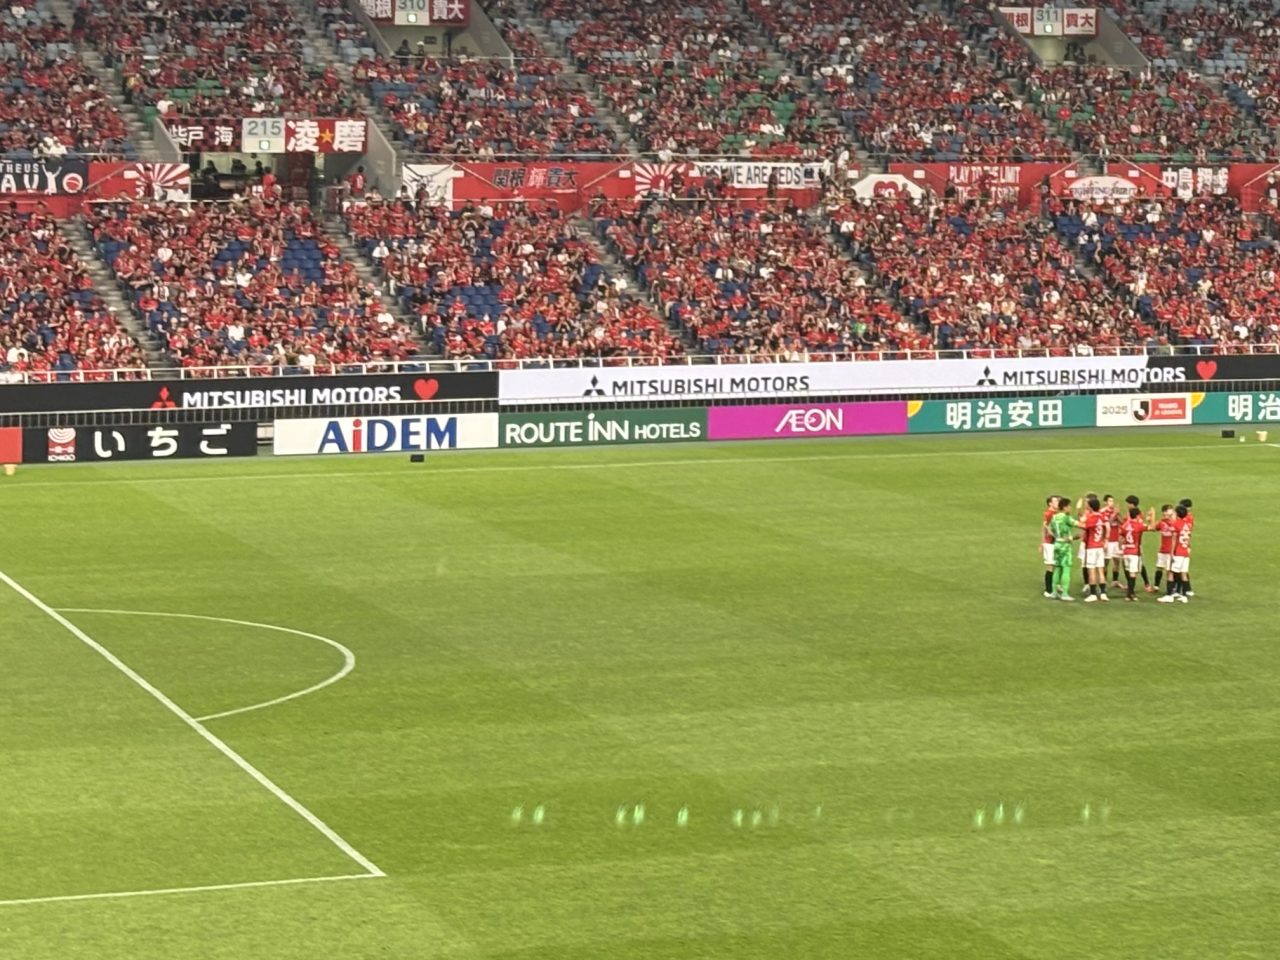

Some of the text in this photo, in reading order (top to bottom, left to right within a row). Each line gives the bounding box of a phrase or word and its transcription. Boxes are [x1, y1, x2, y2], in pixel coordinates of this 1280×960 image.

[1036, 10, 1059, 22] 311
[247, 120, 282, 136] 215
[612, 375, 810, 395] MITSUBISHI MOTORS
[1003, 366, 1185, 385] MITSUBISHI MOTORS
[183, 386, 402, 408] MITSUBISHI MOTORS
[946, 399, 1063, 430] 明治安田
[1101, 405, 1128, 415] 2025
[94, 424, 232, 458] いちご
[318, 417, 458, 452] AiDEM
[505, 421, 583, 444] ROUTE
[634, 423, 701, 439] HOTELS
